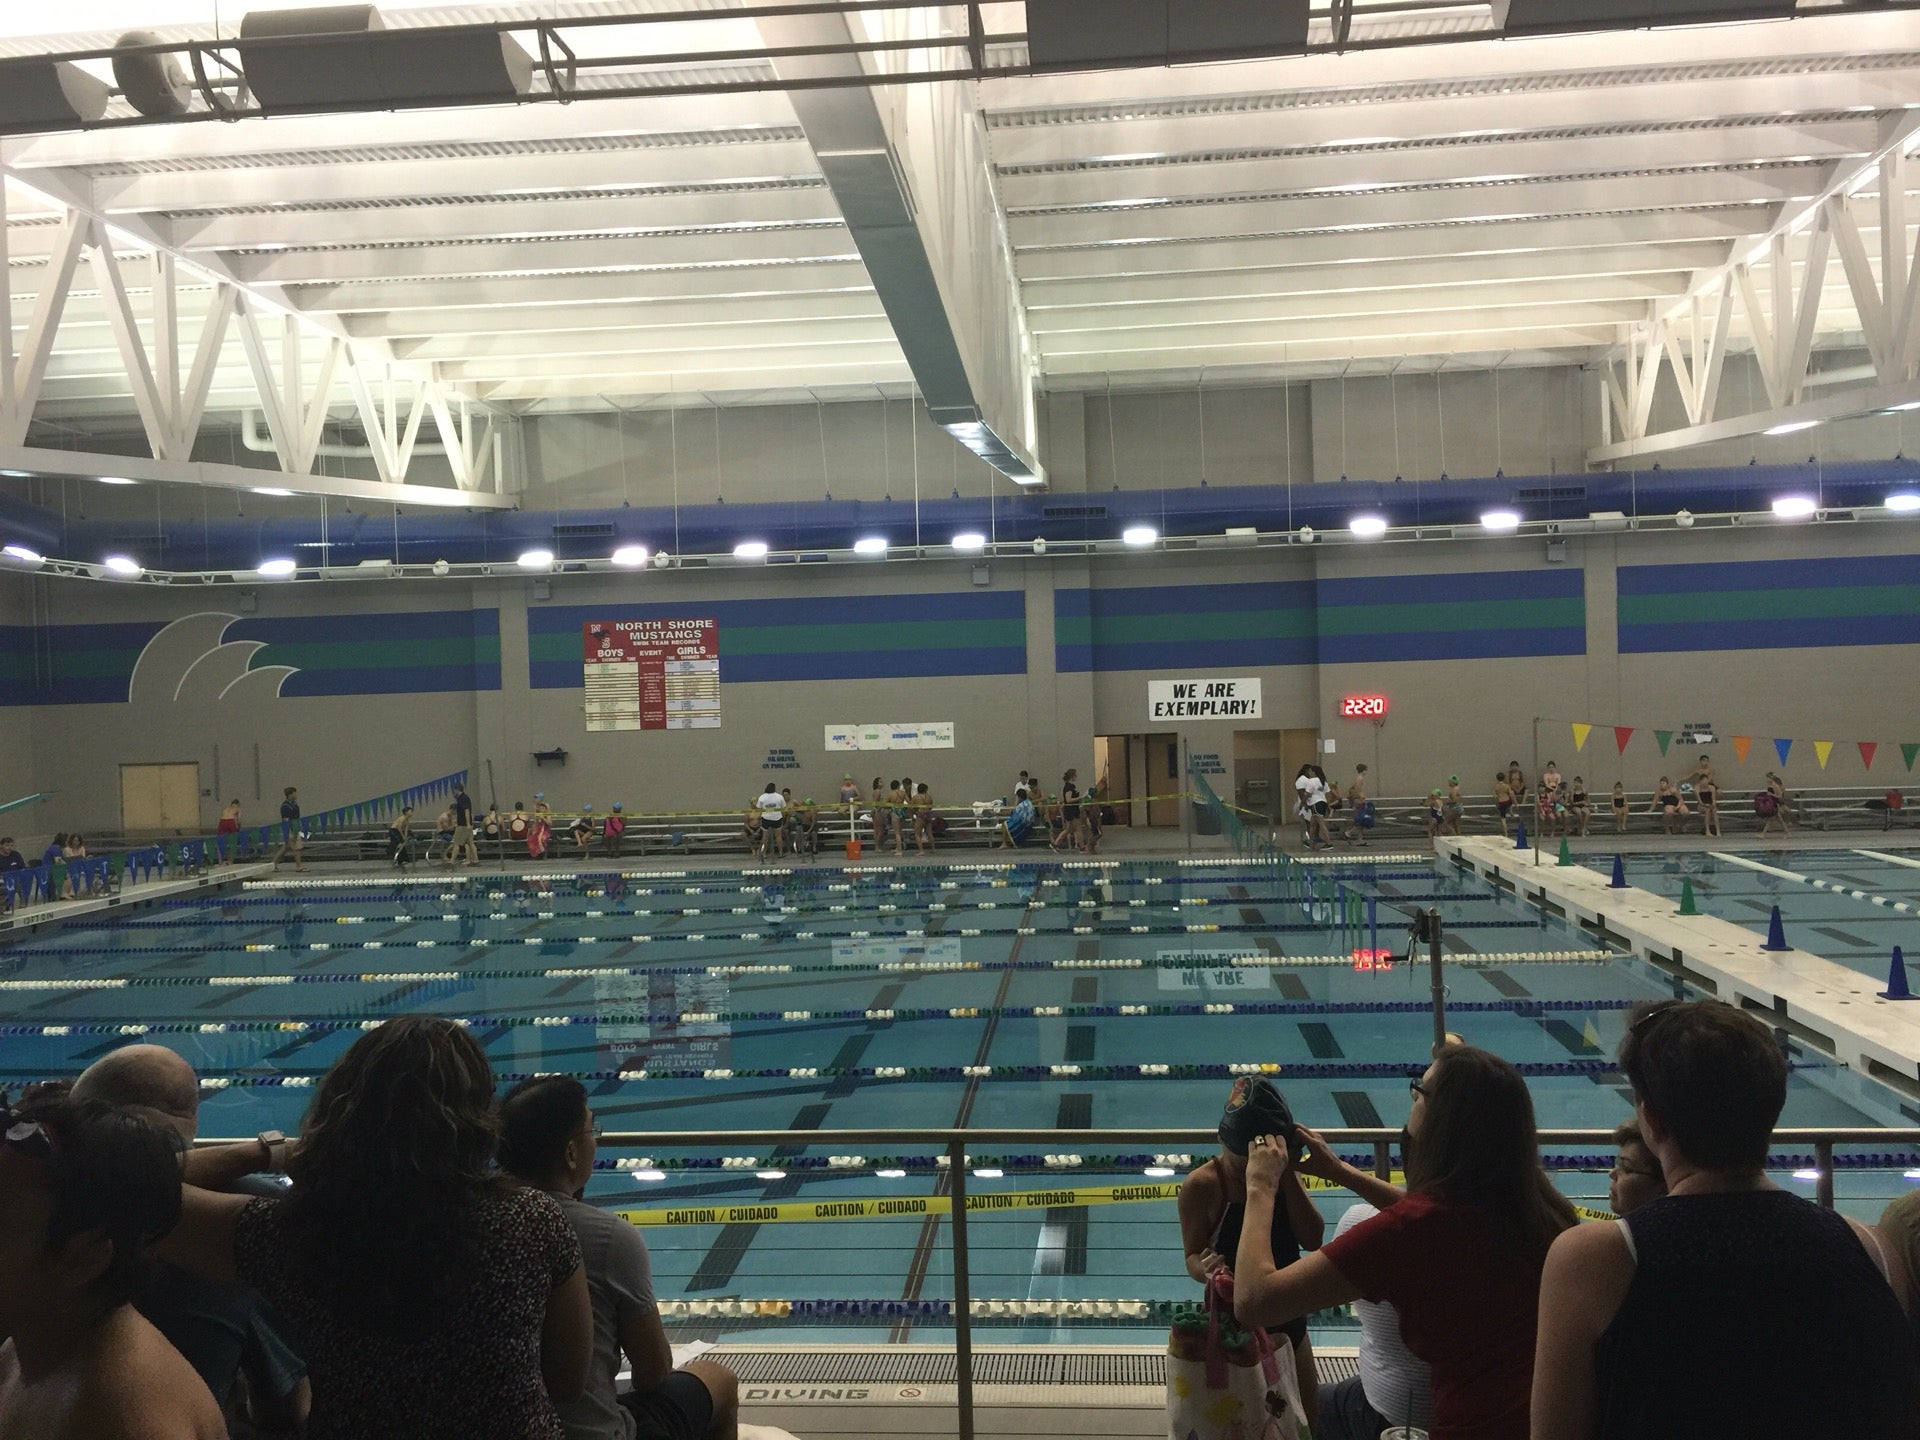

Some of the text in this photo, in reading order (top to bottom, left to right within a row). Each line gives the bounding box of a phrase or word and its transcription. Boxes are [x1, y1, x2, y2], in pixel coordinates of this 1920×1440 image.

[615, 619, 713, 631] NORTH SHORE
[629, 630, 702, 640] MUSTANGS
[597, 648, 624, 657] BOYS
[676, 646, 706, 655] GIRLS
[1173, 682, 1236, 698] WE ARE
[1154, 699, 1256, 717] EXEMPLARY!
[666, 1209, 715, 1223] CAUTION
[729, 1207, 778, 1221] CUIDADO
[815, 1203, 864, 1217] CAUTION
[878, 1199, 927, 1214] CUIDADO
[965, 1195, 1013, 1209] CAUTION
[1026, 1191, 1075, 1206] CUIDADO
[1112, 1186, 1161, 1201] CAUTION
[744, 1389, 870, 1400] DIVING
